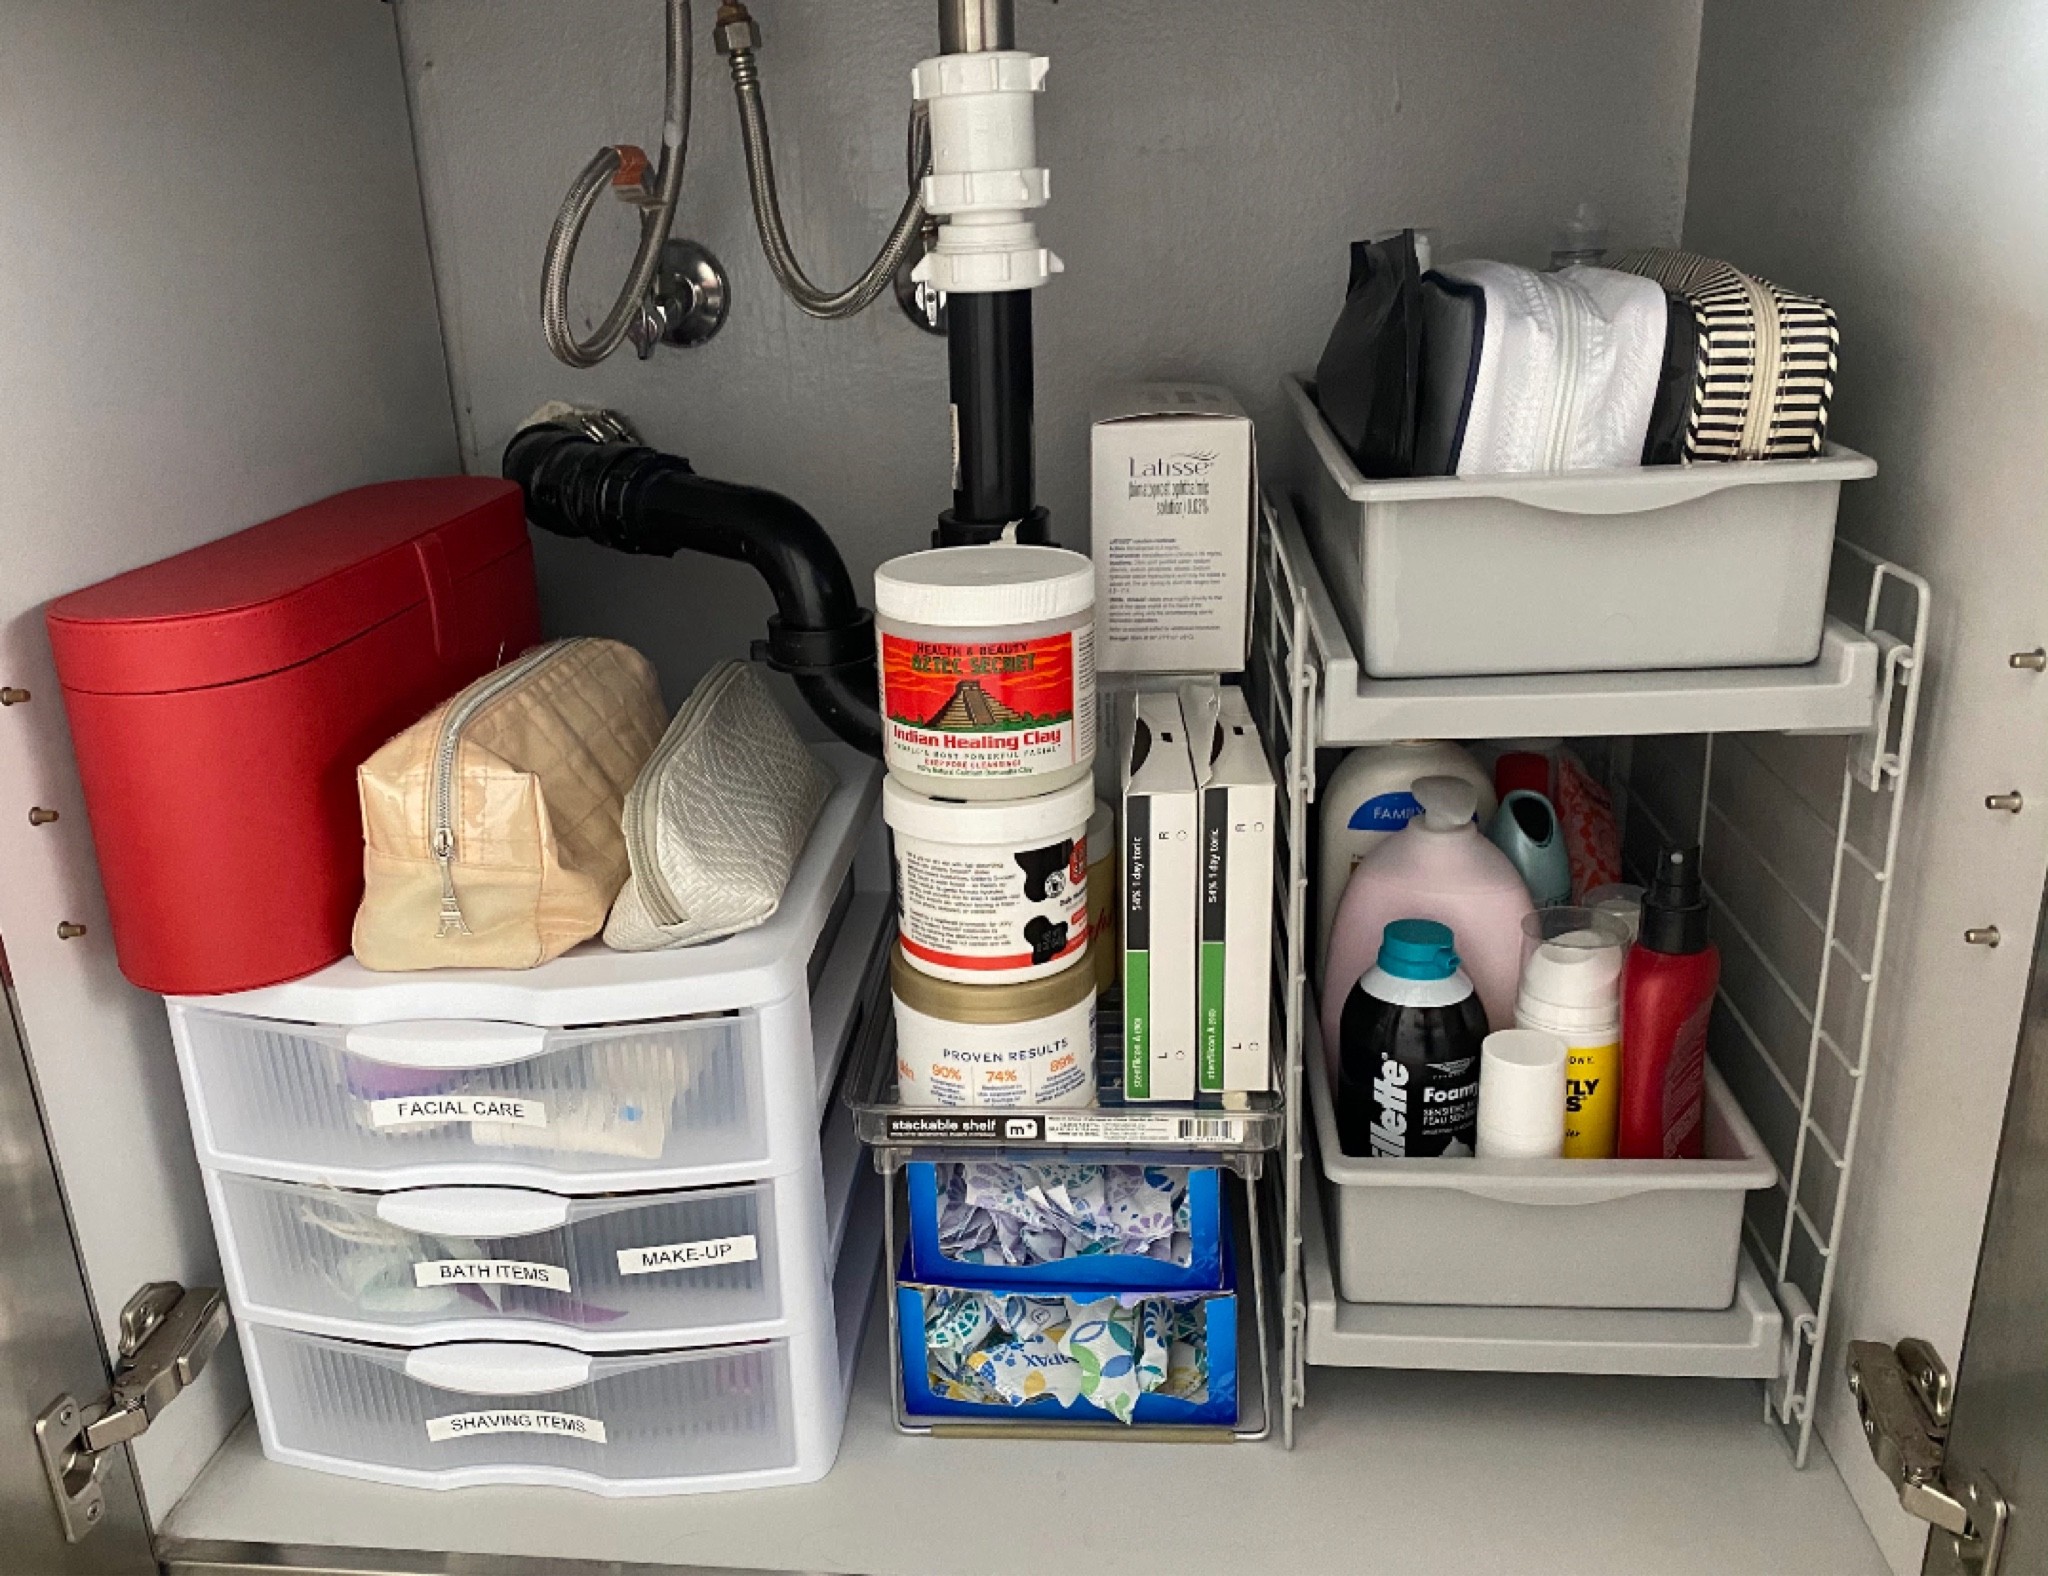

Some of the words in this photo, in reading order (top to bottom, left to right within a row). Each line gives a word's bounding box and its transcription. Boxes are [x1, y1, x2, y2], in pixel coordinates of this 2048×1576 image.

[1128, 456, 1208, 478] Latisse
[917, 643, 961, 656] HEALTH
[979, 643, 1029, 656] BEAUTY
[911, 655, 963, 674] AZTEC
[969, 653, 1036, 674] SECRET
[893, 725, 939, 747] Indian
[944, 732, 1020, 751] Healing
[1023, 728, 1061, 746] Clay
[1131, 862, 1144, 880] day
[1208, 854, 1221, 872] day
[943, 1047, 1004, 1063] PROVEN
[1008, 1037, 1069, 1061] RESULTS
[985, 1069, 1018, 1084] 74%
[1566, 1078, 1600, 1095] TLY
[397, 1101, 469, 1117] FACIAL
[473, 1101, 525, 1118] CARE
[892, 1118, 959, 1131] stackable
[962, 1118, 997, 1131] shelf
[642, 1244, 732, 1267] MAKE-UP
[439, 1265, 490, 1279] BATH
[495, 1265, 550, 1282] ITEMS
[450, 1414, 532, 1432] SHAVING
[536, 1414, 587, 1434] ITEMS
